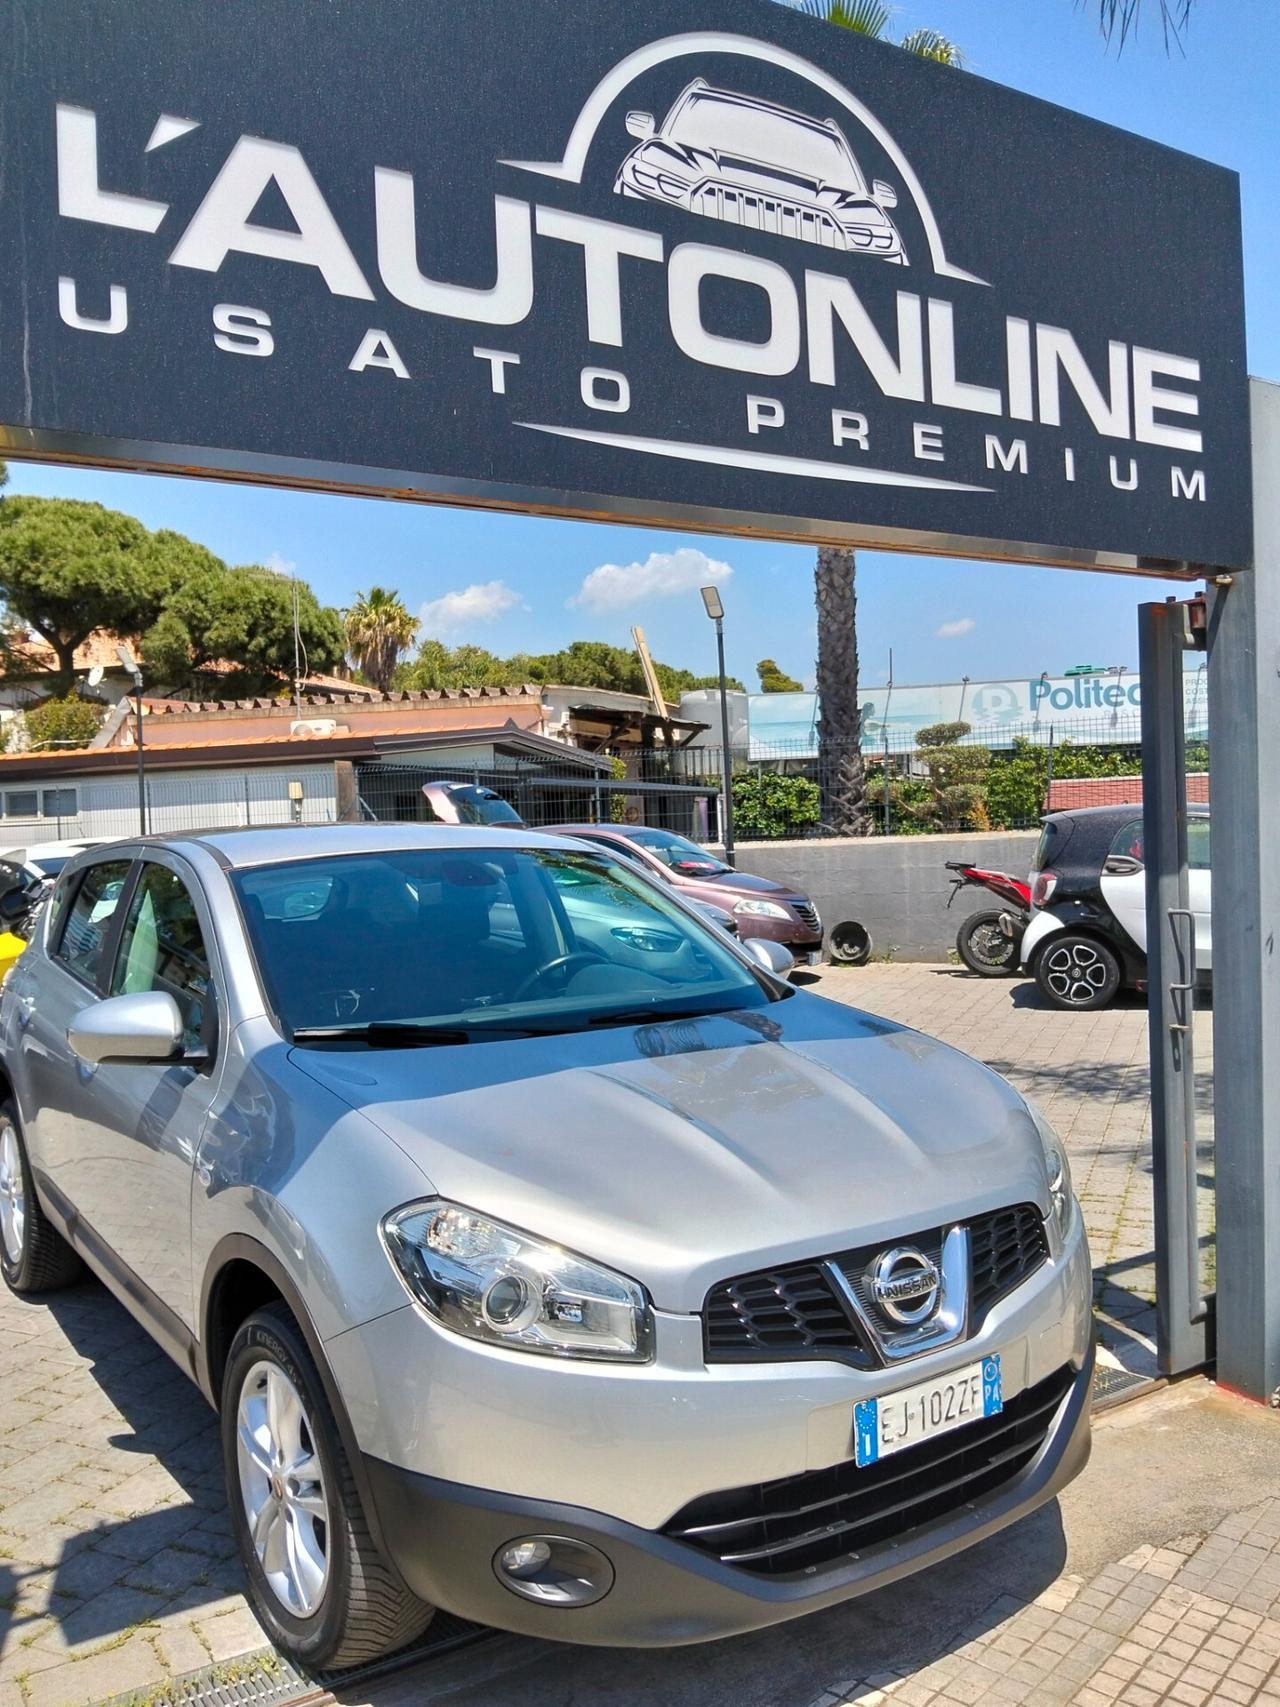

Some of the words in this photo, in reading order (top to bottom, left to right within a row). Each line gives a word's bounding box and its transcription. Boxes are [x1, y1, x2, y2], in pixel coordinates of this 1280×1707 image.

[59, 277, 630, 412] USATO
[747, 395, 1205, 501] PREMIUM
[884, 1275, 937, 1298] NISSAN
[984, 1385, 1000, 1401] PA
